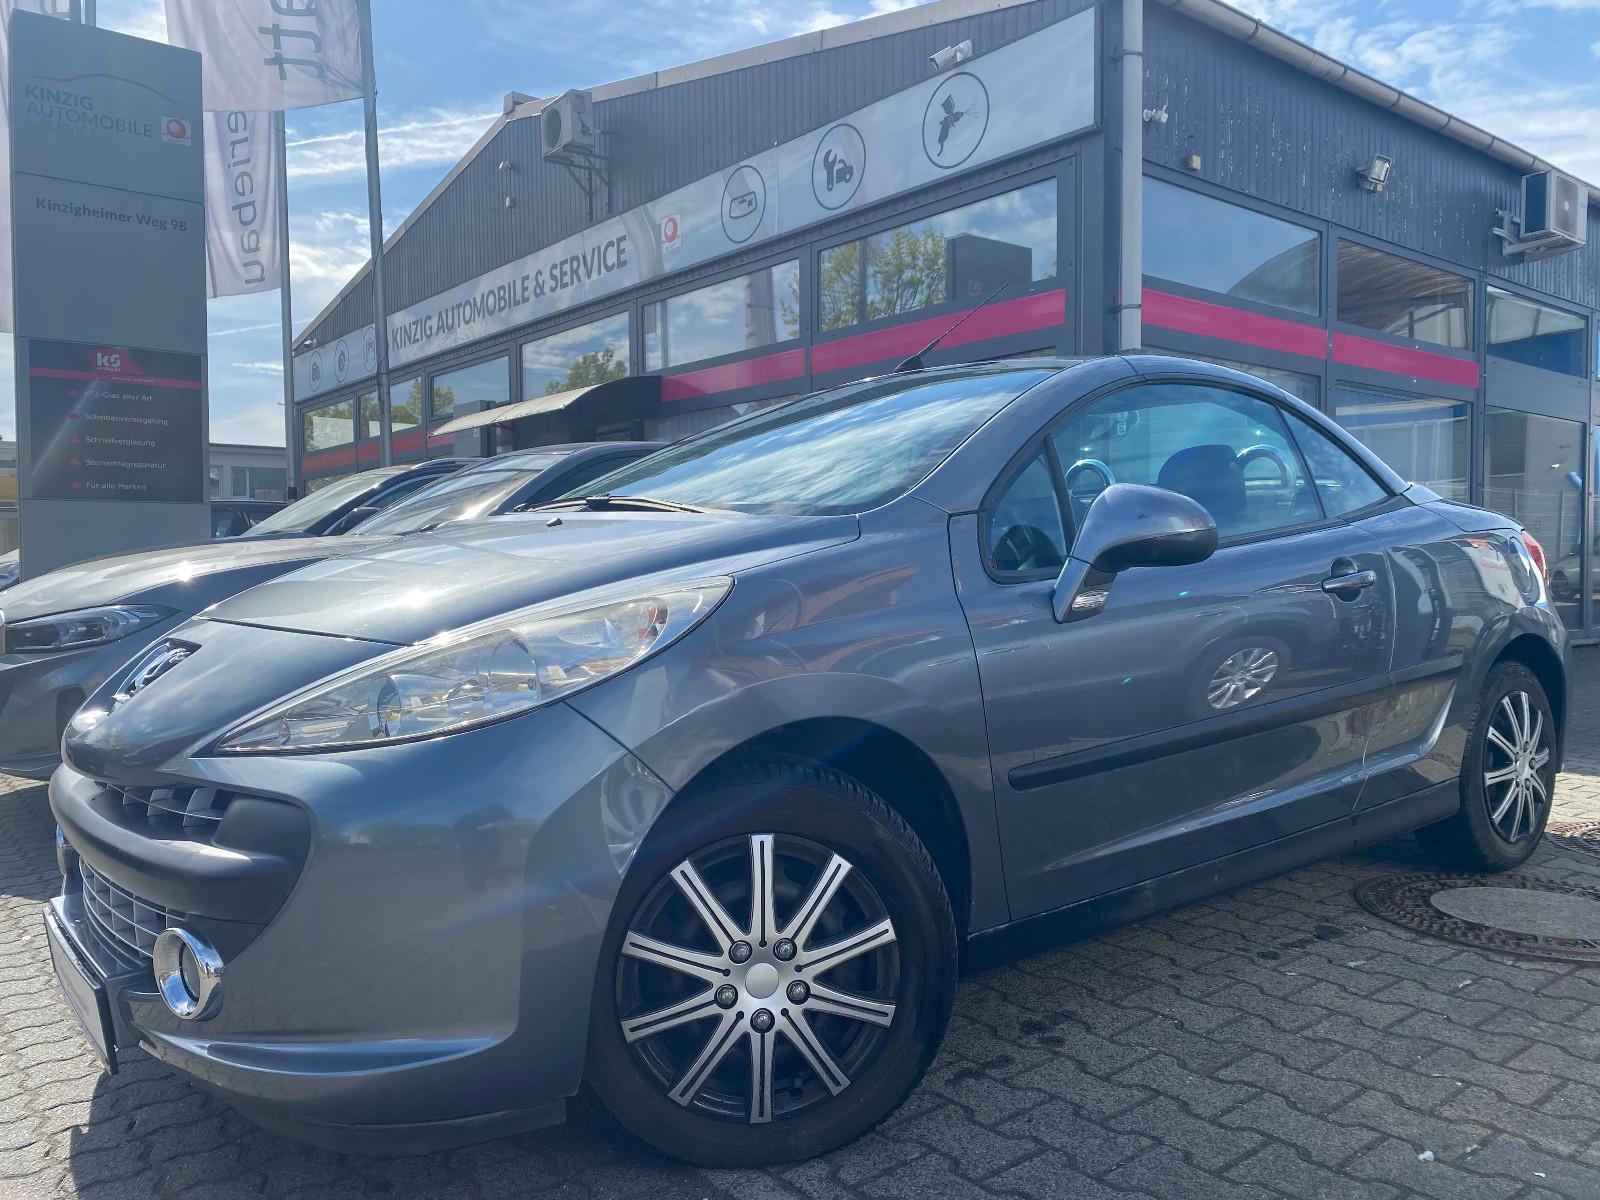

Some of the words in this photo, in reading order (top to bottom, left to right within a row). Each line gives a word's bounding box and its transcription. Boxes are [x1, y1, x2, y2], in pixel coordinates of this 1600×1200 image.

[25, 84, 93, 111] KINZIG
[26, 101, 153, 138] AUTOMOBILE
[35, 197, 133, 223] Kinzigheimer
[136, 212, 168, 231] Weg
[170, 219, 187, 231] 98
[391, 314, 433, 353] KINZIG
[436, 274, 530, 337] AUTOMOBILE
[533, 269, 546, 298] &
[549, 234, 628, 293] SERVICE
[85, 413, 169, 425] Scheibenversiegelung
[85, 436, 156, 447] Schnellverglasung
[85, 458, 166, 469] Steinschlagreparatur
[86, 481, 100, 489] Für
[102, 482, 115, 490] alle
[118, 482, 147, 490] Marken
